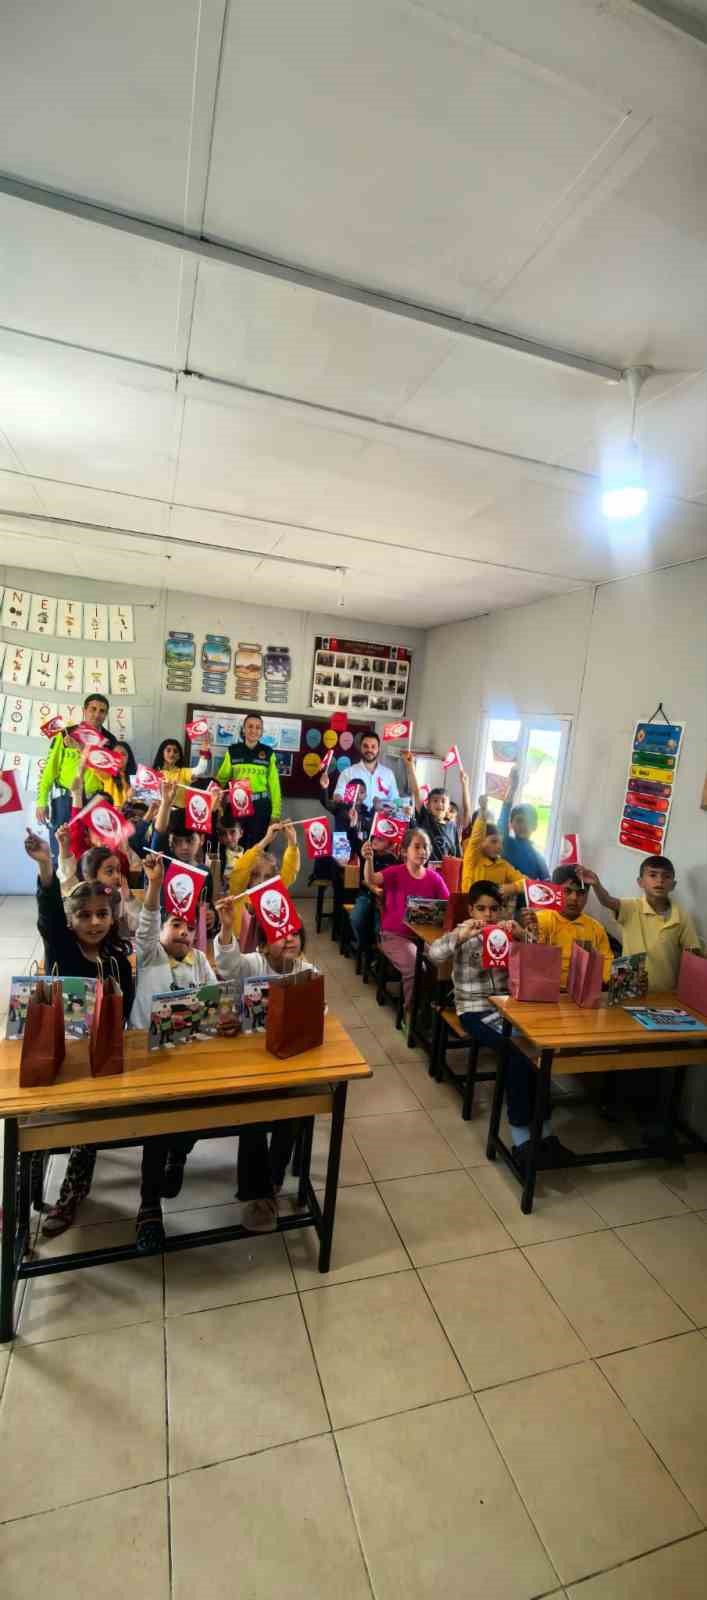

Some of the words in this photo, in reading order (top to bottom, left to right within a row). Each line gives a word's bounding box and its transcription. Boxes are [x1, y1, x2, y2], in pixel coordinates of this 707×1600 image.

[12, 591, 23, 603] N
[41, 599, 48, 609] E
[67, 603, 73, 613] T
[118, 607, 125, 617] L
[15, 648, 24, 658] K
[40, 653, 50, 663] U
[67, 658, 74, 668] R
[116, 660, 128, 670] M
[16, 699, 22, 710] S
[67, 705, 75, 718] Y
[116, 708, 124, 719] Z
[14, 755, 21, 765] B
[191, 821, 208, 831] ATA
[313, 849, 328, 857] ATA
[275, 923, 295, 938] ATA
[488, 958, 506, 967] ATA
